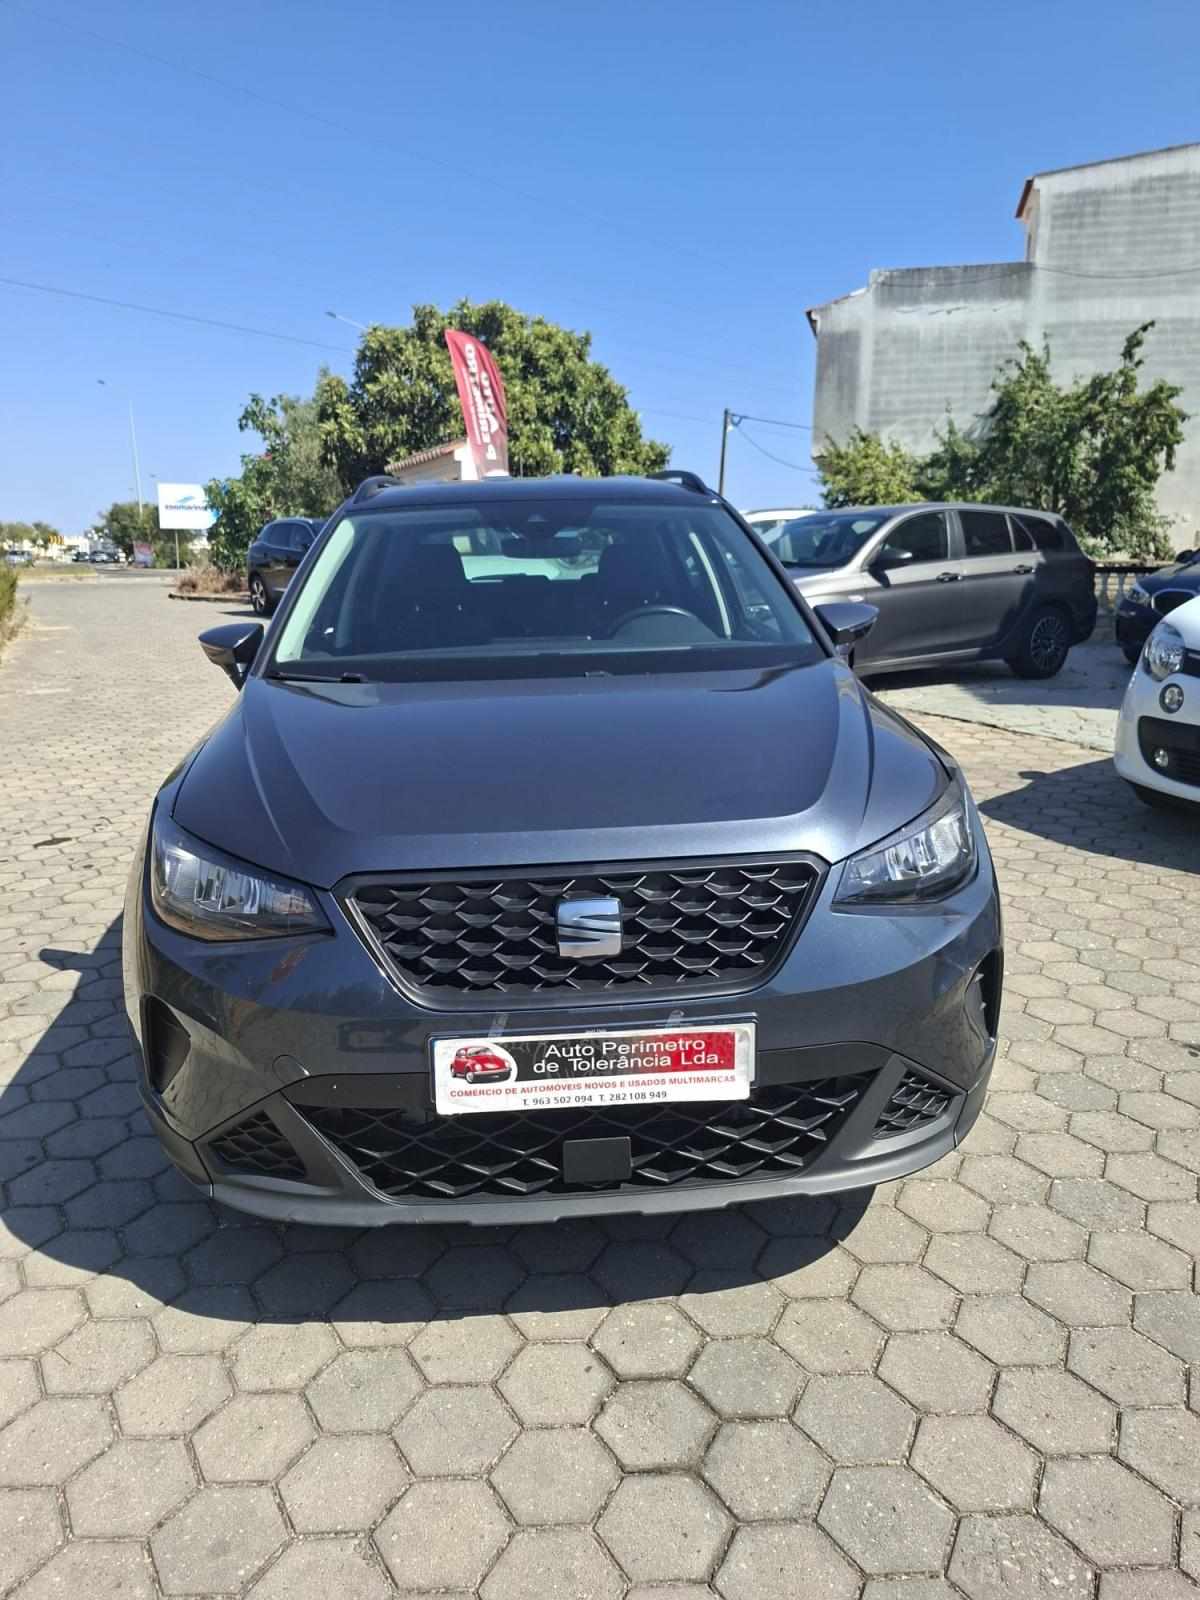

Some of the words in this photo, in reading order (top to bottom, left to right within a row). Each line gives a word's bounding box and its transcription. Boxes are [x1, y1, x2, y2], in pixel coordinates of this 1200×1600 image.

[545, 1043, 595, 1058] Auto
[532, 1059, 560, 1073] de
[567, 1054, 671, 1072] Tolerância
[680, 1051, 724, 1065] Lda.
[505, 1087, 518, 1095] DE
[584, 1081, 617, 1090] NOVOS
[628, 1079, 666, 1088] USADOS
[668, 1075, 736, 1085] MULTIMARCAS
[532, 1097, 551, 1106] 963
[554, 1096, 571, 1104] 502
[574, 1094, 593, 1103] 094
[649, 1090, 667, 1099] 949
